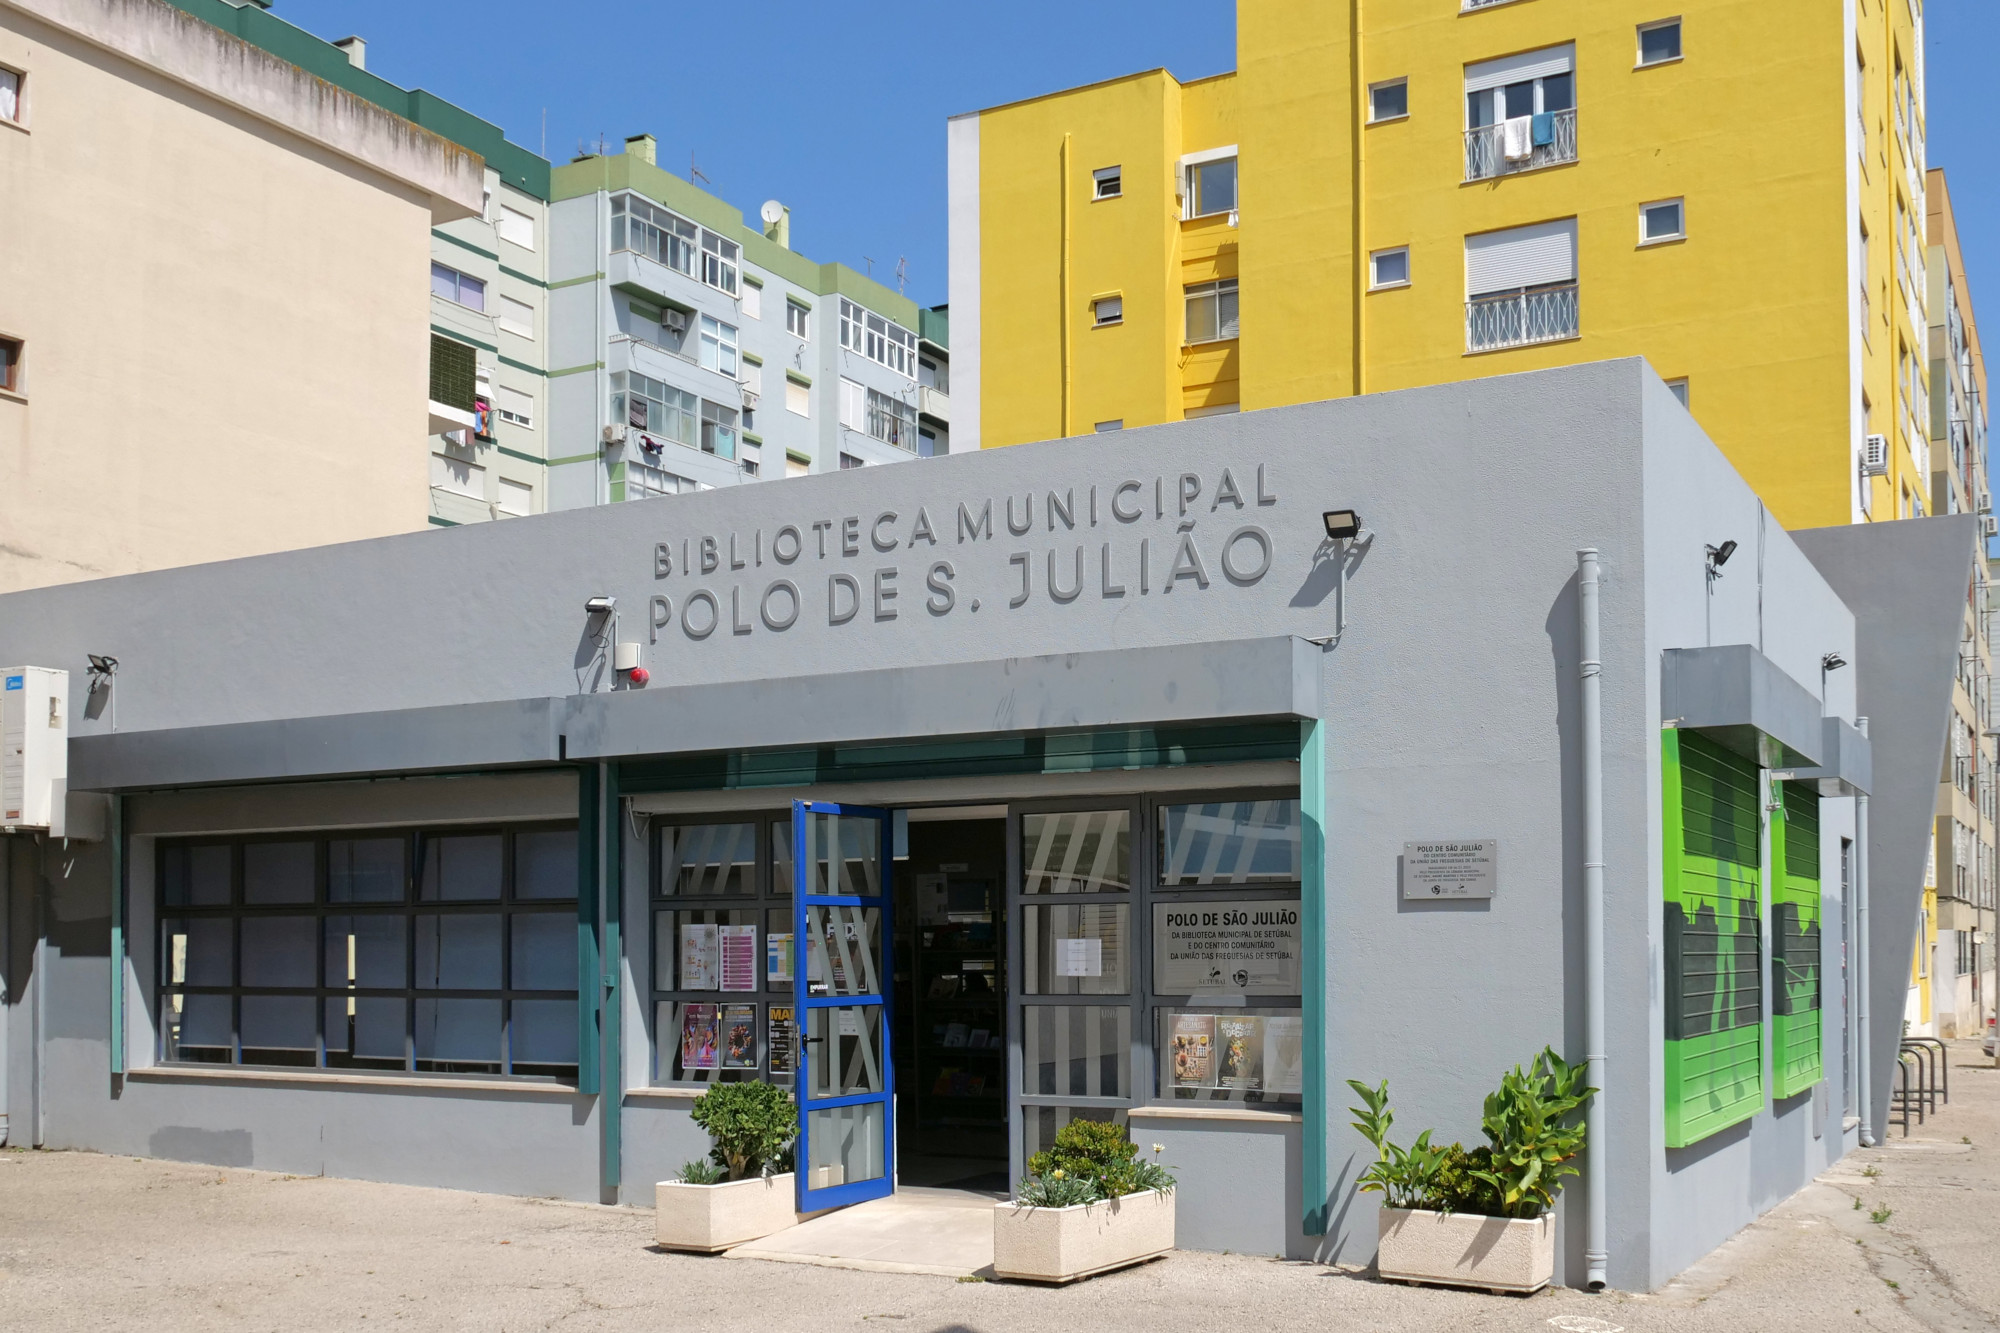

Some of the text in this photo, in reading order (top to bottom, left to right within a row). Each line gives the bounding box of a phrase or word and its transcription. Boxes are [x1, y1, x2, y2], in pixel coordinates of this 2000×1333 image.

[653, 463, 1277, 579] BIBLIOTECA MUNICIPAL
[650, 519, 1275, 643] POLO DE S. JULIÃO
[1445, 844, 1457, 852] SÃO
[1460, 843, 1482, 851] JULIÃO
[1167, 908, 1297, 926] POLO DE SÃO JULIÃO
[1172, 931, 1180, 939] DA
[1182, 931, 1216, 939] BIBLIOTECA
[1218, 930, 1252, 938] MUNICIPAL
[1264, 929, 1292, 938] SETÚBAL
[1204, 941, 1229, 949] CENTRO
[1231, 939, 1275, 949] COMUNITÁRIO
[1181, 951, 1199, 960] UNIÃO
[1201, 952, 1213, 960] DAS
[1215, 952, 1253, 960] FREGUESIAS
[1266, 950, 1293, 960] SETÚBAL
